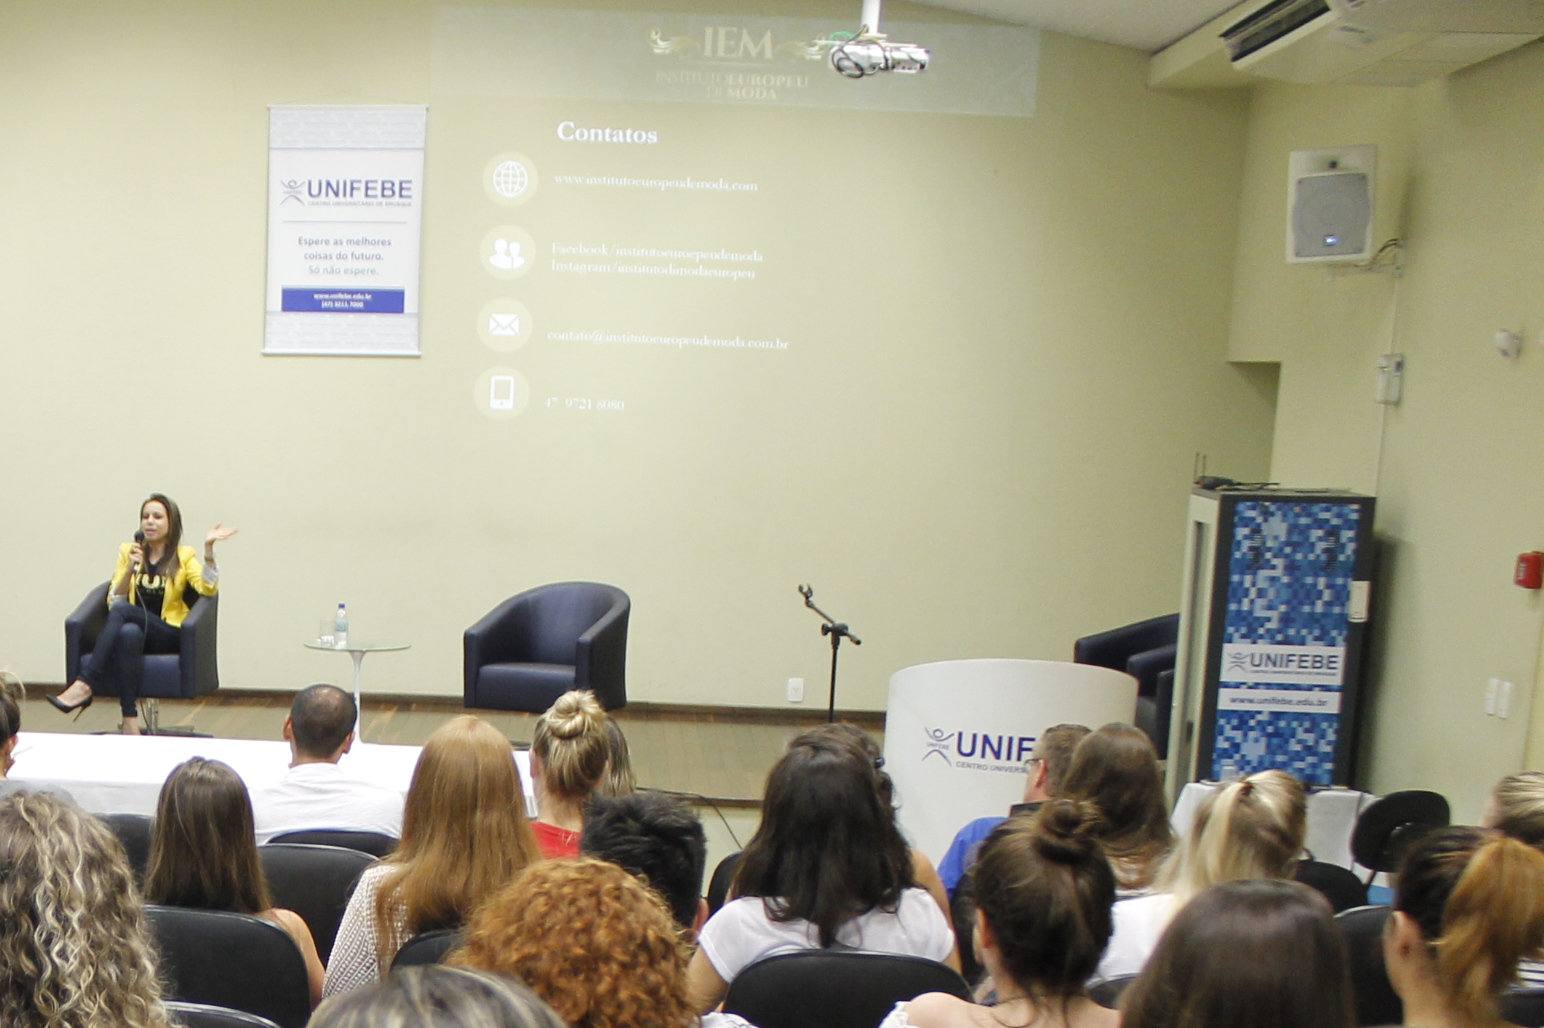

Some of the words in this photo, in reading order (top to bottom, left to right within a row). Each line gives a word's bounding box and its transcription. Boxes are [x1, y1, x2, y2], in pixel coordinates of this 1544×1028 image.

[703, 26, 773, 59] IEM
[727, 86, 777, 99] MODA
[557, 121, 658, 144] Contatos
[307, 179, 412, 198] UNIFEBE
[298, 236, 330, 247] Espere
[346, 236, 392, 246] melhores
[304, 251, 333, 260] coisas
[336, 251, 348, 260] do
[351, 251, 384, 260] futuro.
[308, 265, 320, 274] Só
[323, 265, 341, 274] não
[344, 266, 380, 276] espere.
[1251, 652, 1339, 669] UNIFEBE
[957, 731, 1037, 762] UNIF
[956, 761, 988, 771] CENTRO
[990, 765, 1028, 774] UNIVERS
